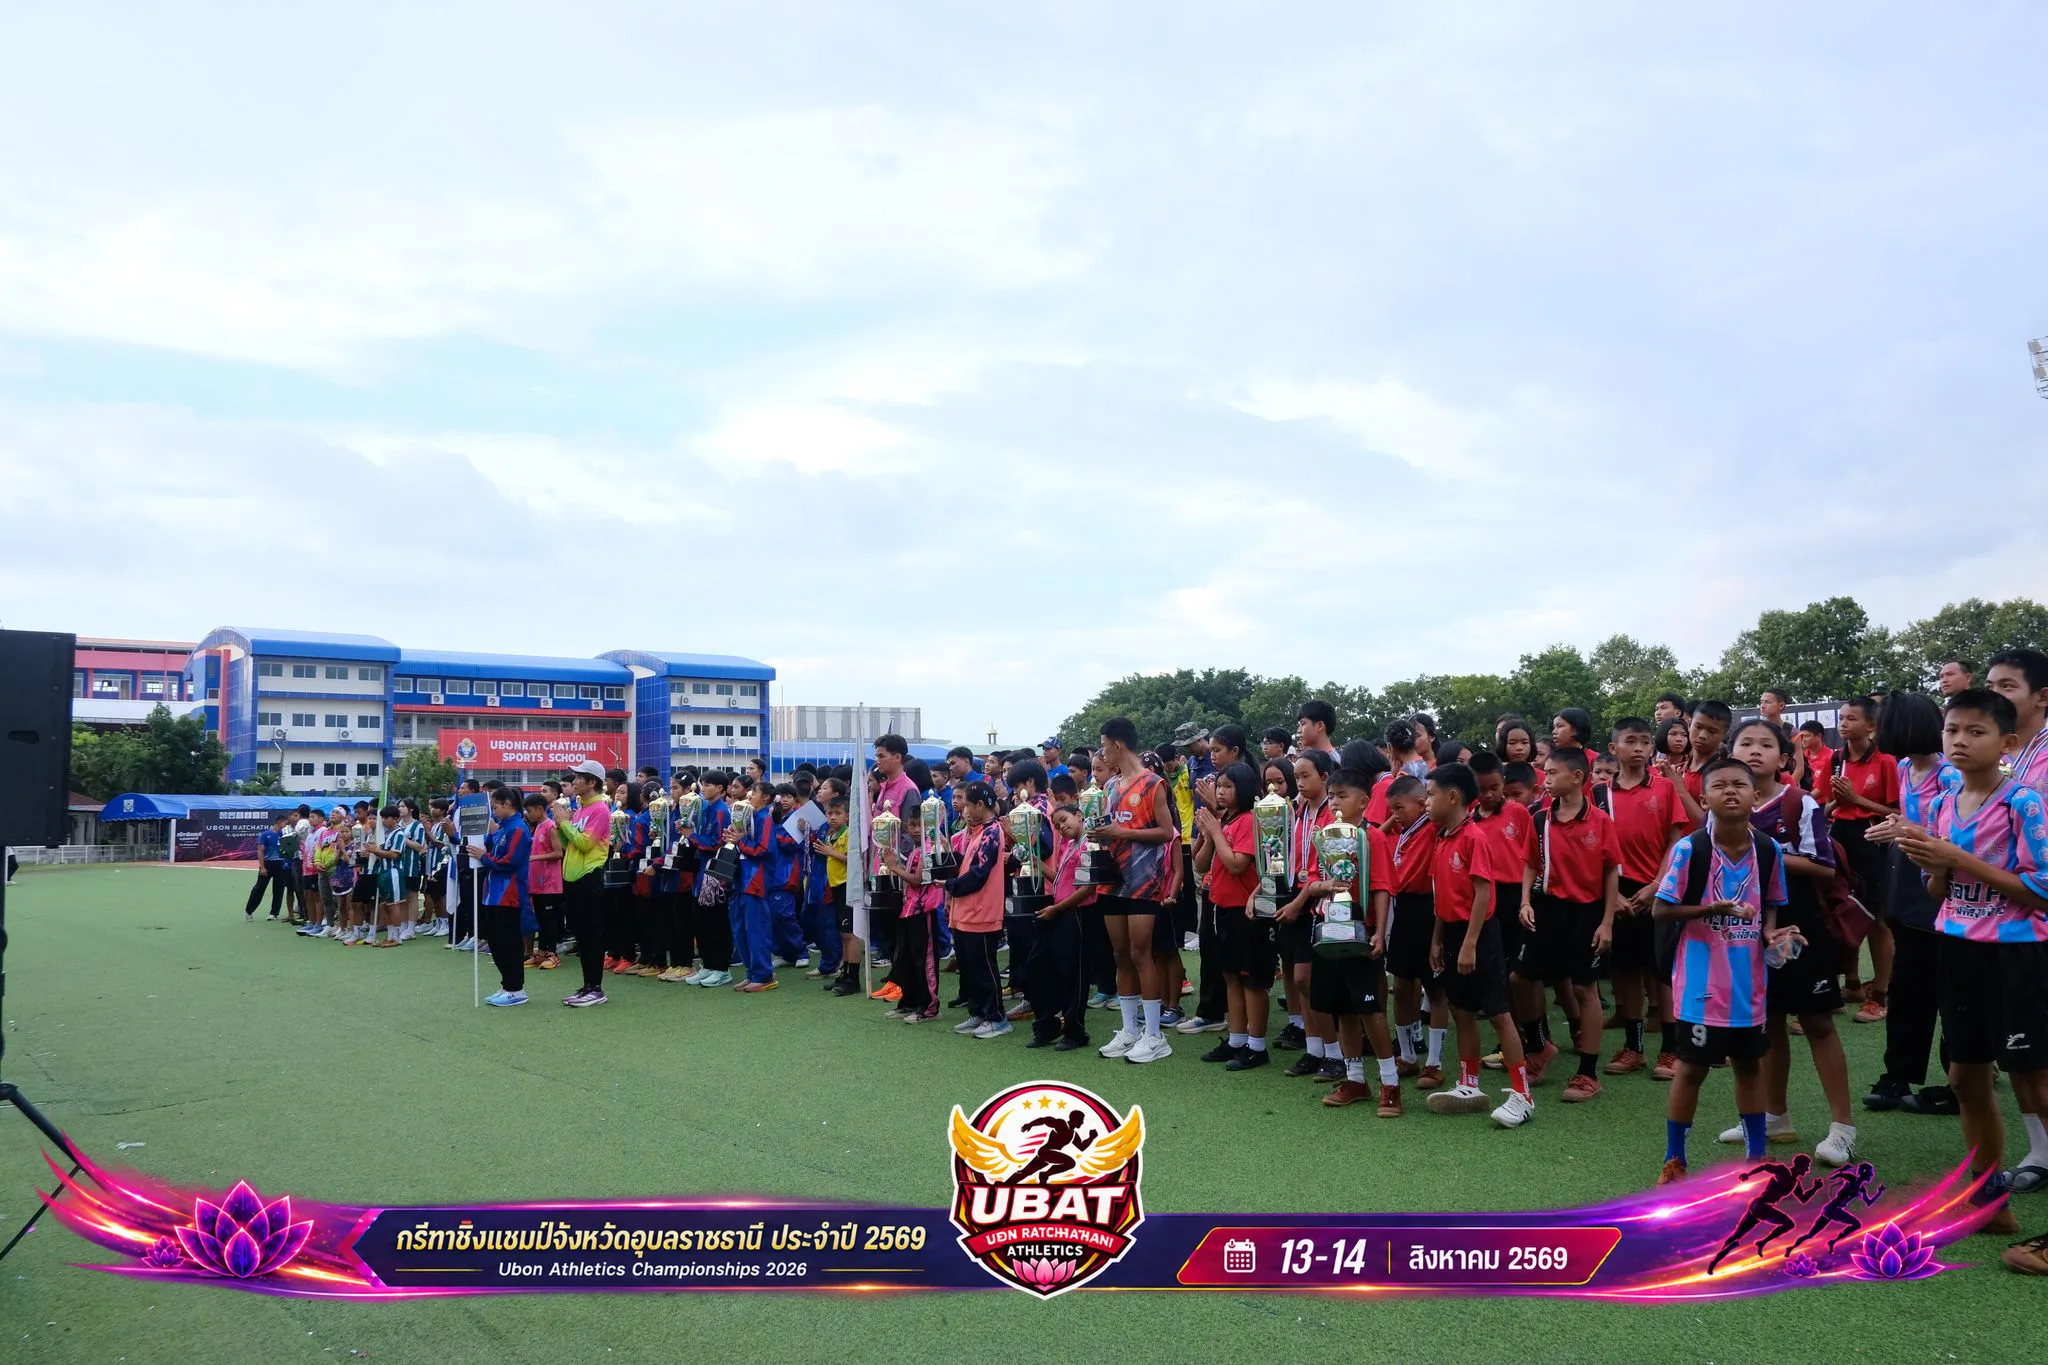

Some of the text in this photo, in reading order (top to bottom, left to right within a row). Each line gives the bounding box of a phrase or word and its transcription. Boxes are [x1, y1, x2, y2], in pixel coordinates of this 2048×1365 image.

[490, 741, 597, 752] UBONRATCHATHANI
[502, 753, 588, 763] SPORTS SCHOOL
[1691, 1024, 1708, 1047] 9
